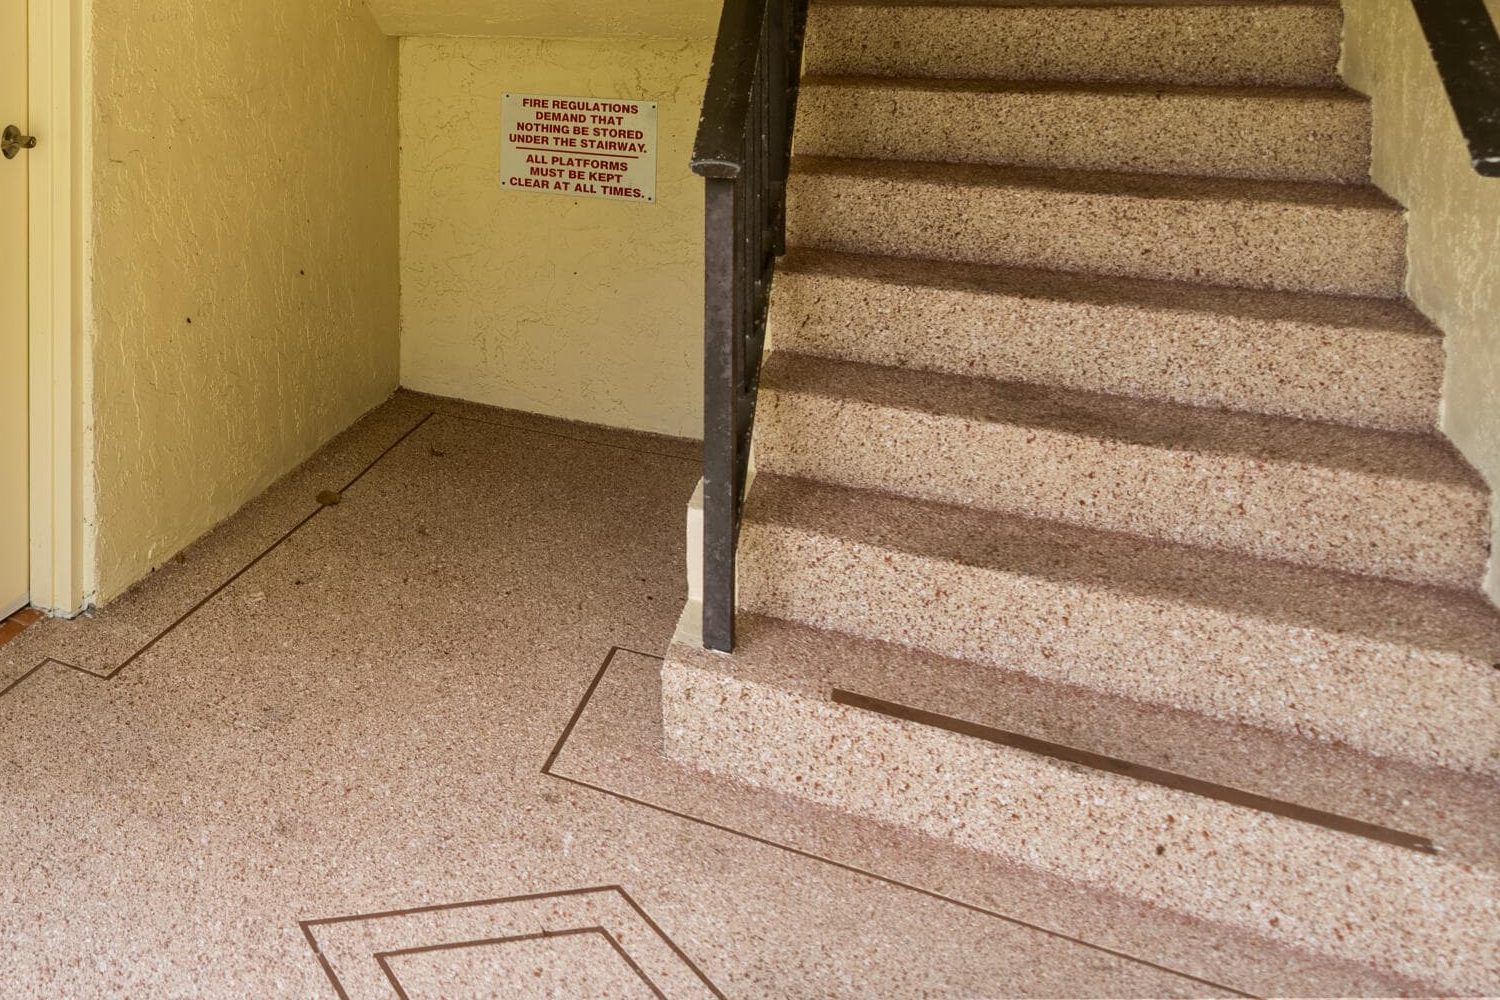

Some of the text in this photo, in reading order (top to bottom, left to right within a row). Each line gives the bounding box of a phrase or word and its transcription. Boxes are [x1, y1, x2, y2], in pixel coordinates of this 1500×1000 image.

[523, 98, 638, 114] FIRE REGULATIONS
[536, 112, 623, 125] DEMAND THAT
[517, 122, 643, 139] NOTHING BE STORED
[509, 134, 647, 153] UNDER THE STAIRWAY.
[526, 155, 628, 171] ALL PLATFORMS
[530, 167, 622, 183] MUST BE KEPT
[510, 177, 644, 198] CLEAR AT ALL TIMES.
